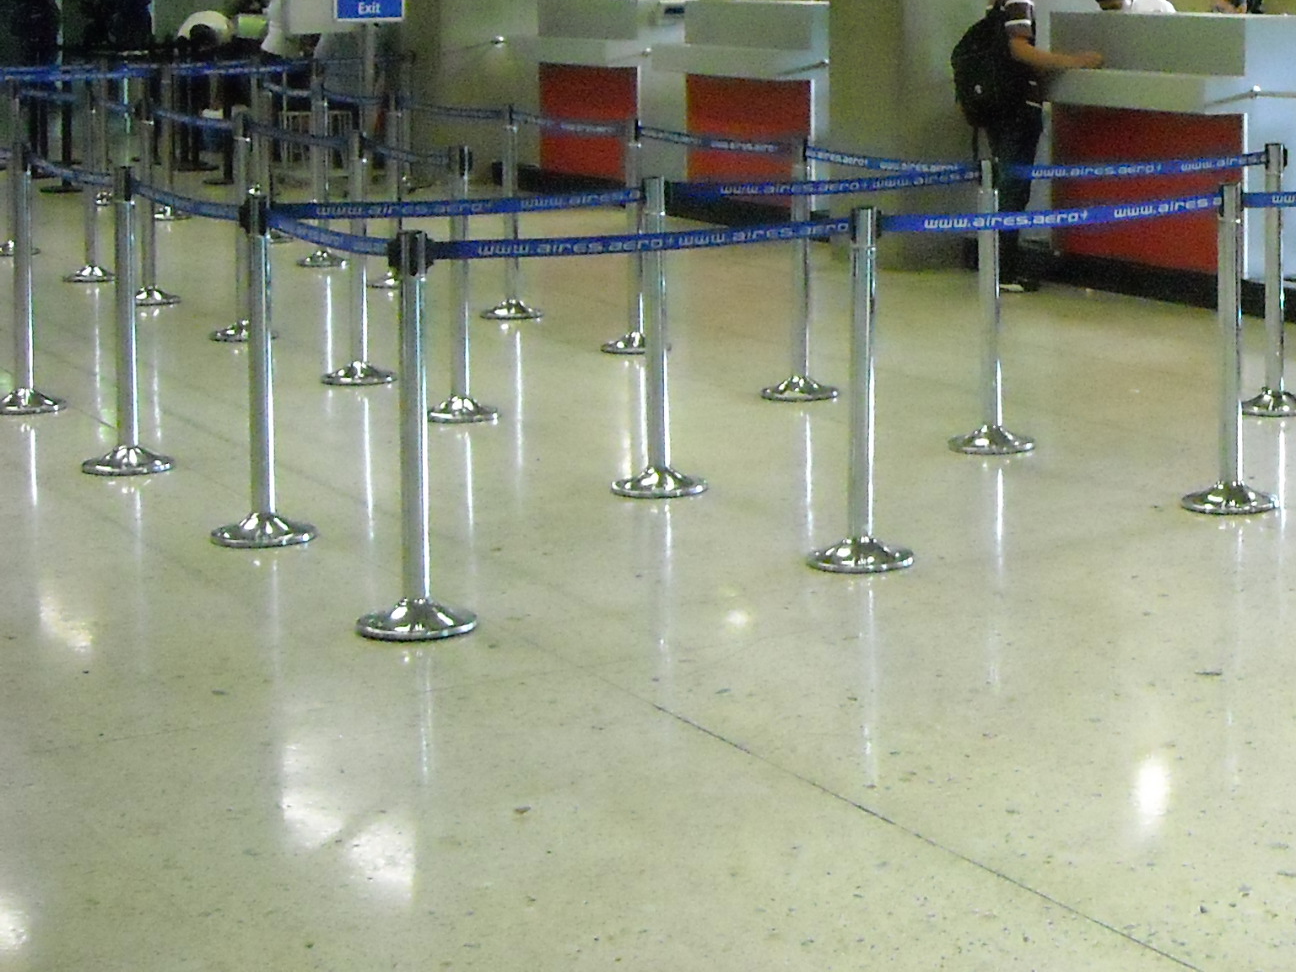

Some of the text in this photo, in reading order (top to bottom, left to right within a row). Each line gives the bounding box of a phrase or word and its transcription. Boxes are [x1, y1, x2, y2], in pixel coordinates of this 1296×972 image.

[358, 1, 382, 15] Exit
[1031, 163, 1158, 179] www.aires.aero
[719, 181, 859, 196] www.aires.aero
[316, 202, 484, 218] www.aires.aero
[924, 212, 1078, 230] www.aires.aero
[478, 222, 849, 256] www.aires.aero www.aires.aero
